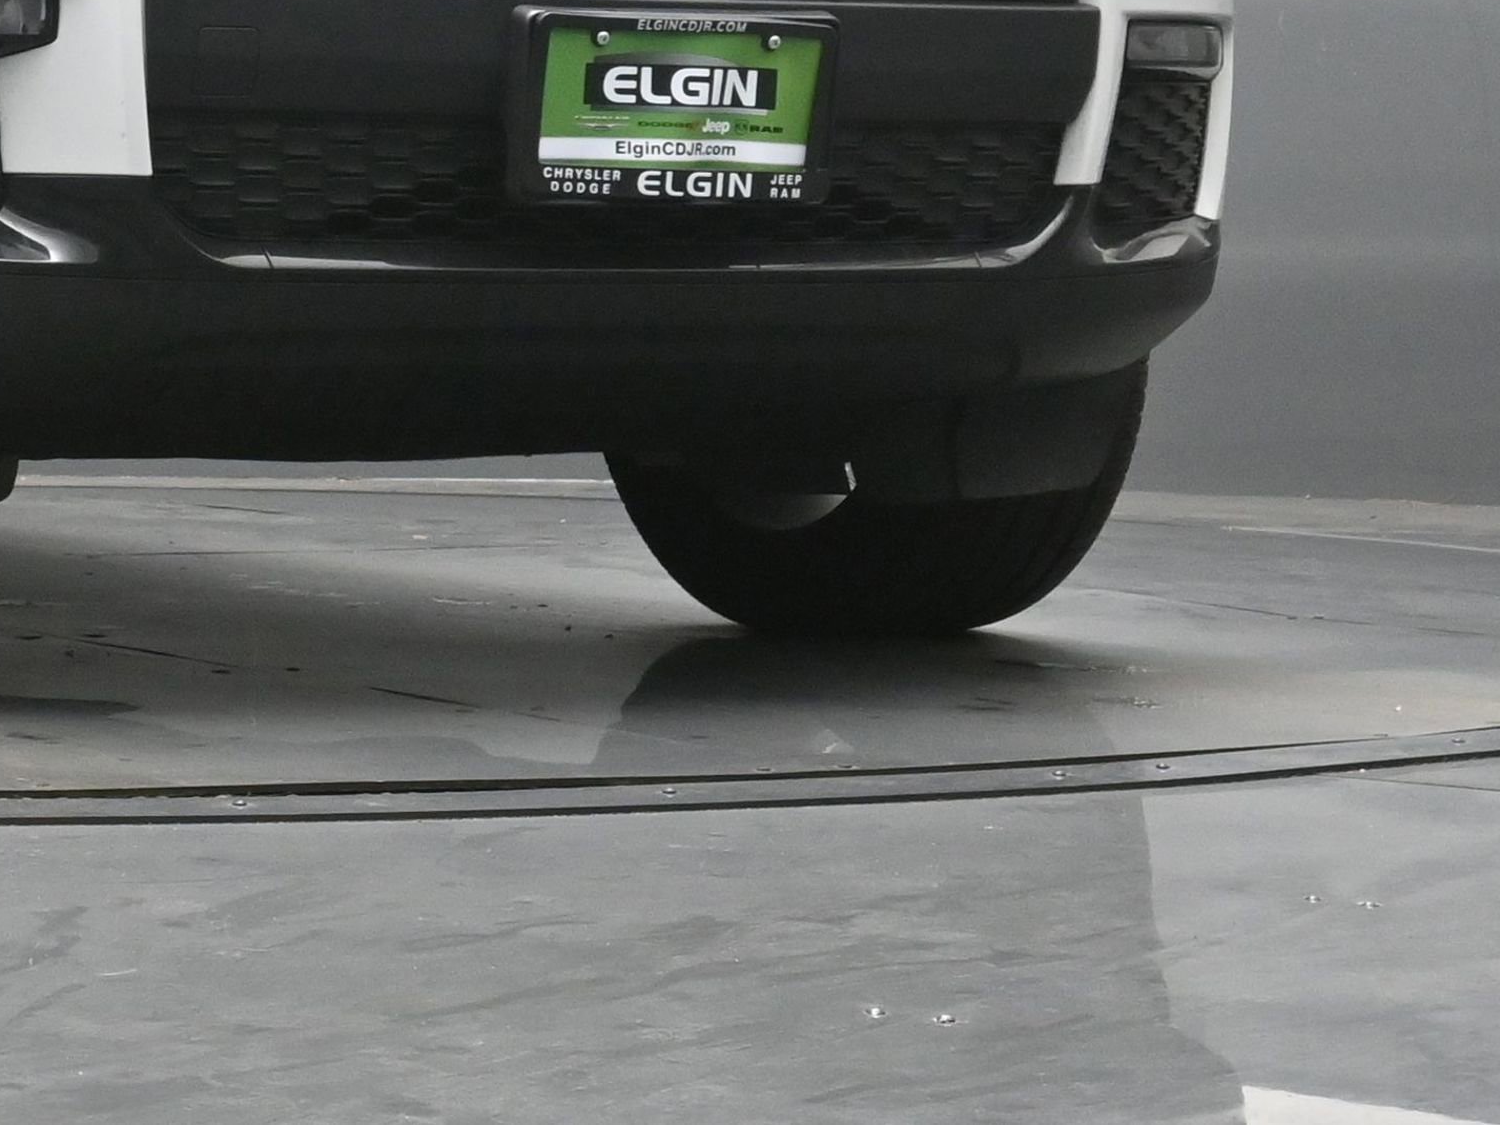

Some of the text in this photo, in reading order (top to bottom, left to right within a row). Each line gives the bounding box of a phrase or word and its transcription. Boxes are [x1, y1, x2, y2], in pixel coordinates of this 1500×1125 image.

[637, 18, 748, 33] ELGINCDJR.COM
[603, 65, 759, 107] ELGIN
[702, 117, 731, 135] Jeep
[615, 140, 737, 158] ElginCDJR.com
[543, 166, 622, 182] CHRYSLER
[769, 174, 802, 185] JEEP
[550, 180, 612, 195] DODGE
[637, 170, 754, 199] ELGIN
[769, 188, 801, 199] RAM
